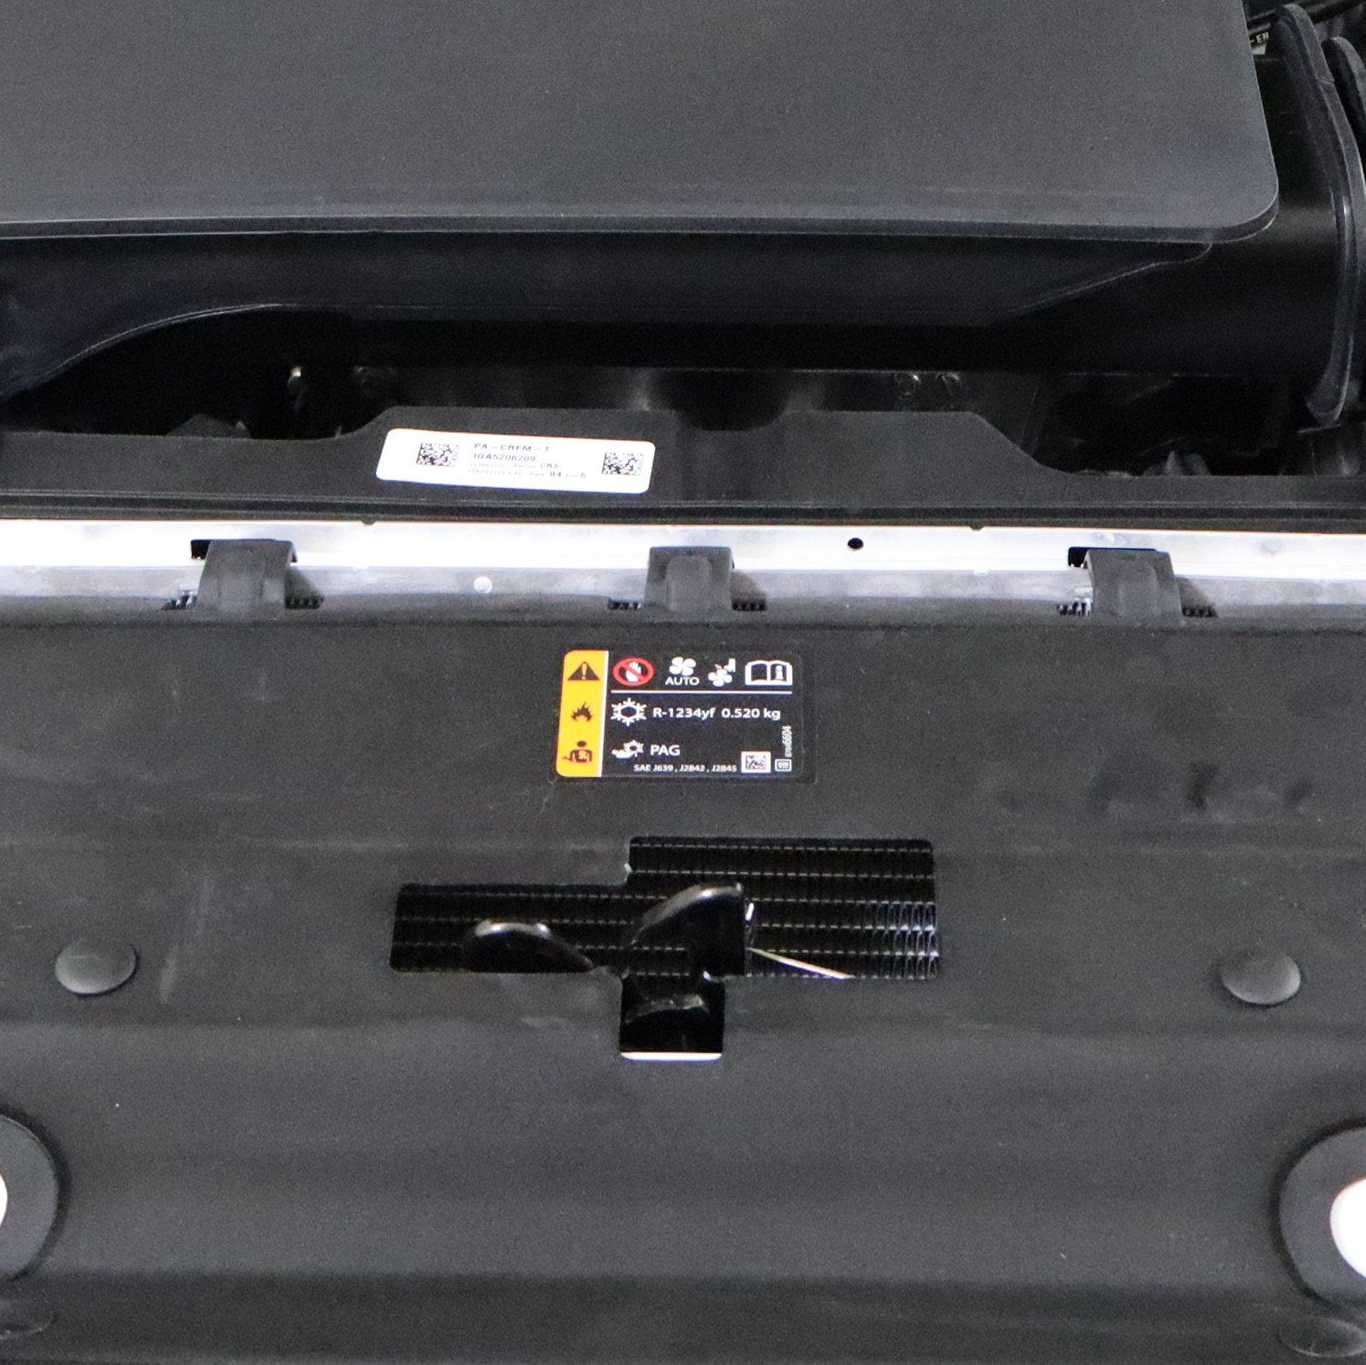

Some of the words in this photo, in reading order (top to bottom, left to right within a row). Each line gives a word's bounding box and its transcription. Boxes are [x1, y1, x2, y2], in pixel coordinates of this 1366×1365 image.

[665, 677, 700, 686] AUTO
[652, 707, 716, 720] R-1234yf
[721, 708, 760, 719] 0.520
[763, 708, 781, 721] kg
[650, 745, 681, 756] PAG
[633, 764, 651, 772] SAE
